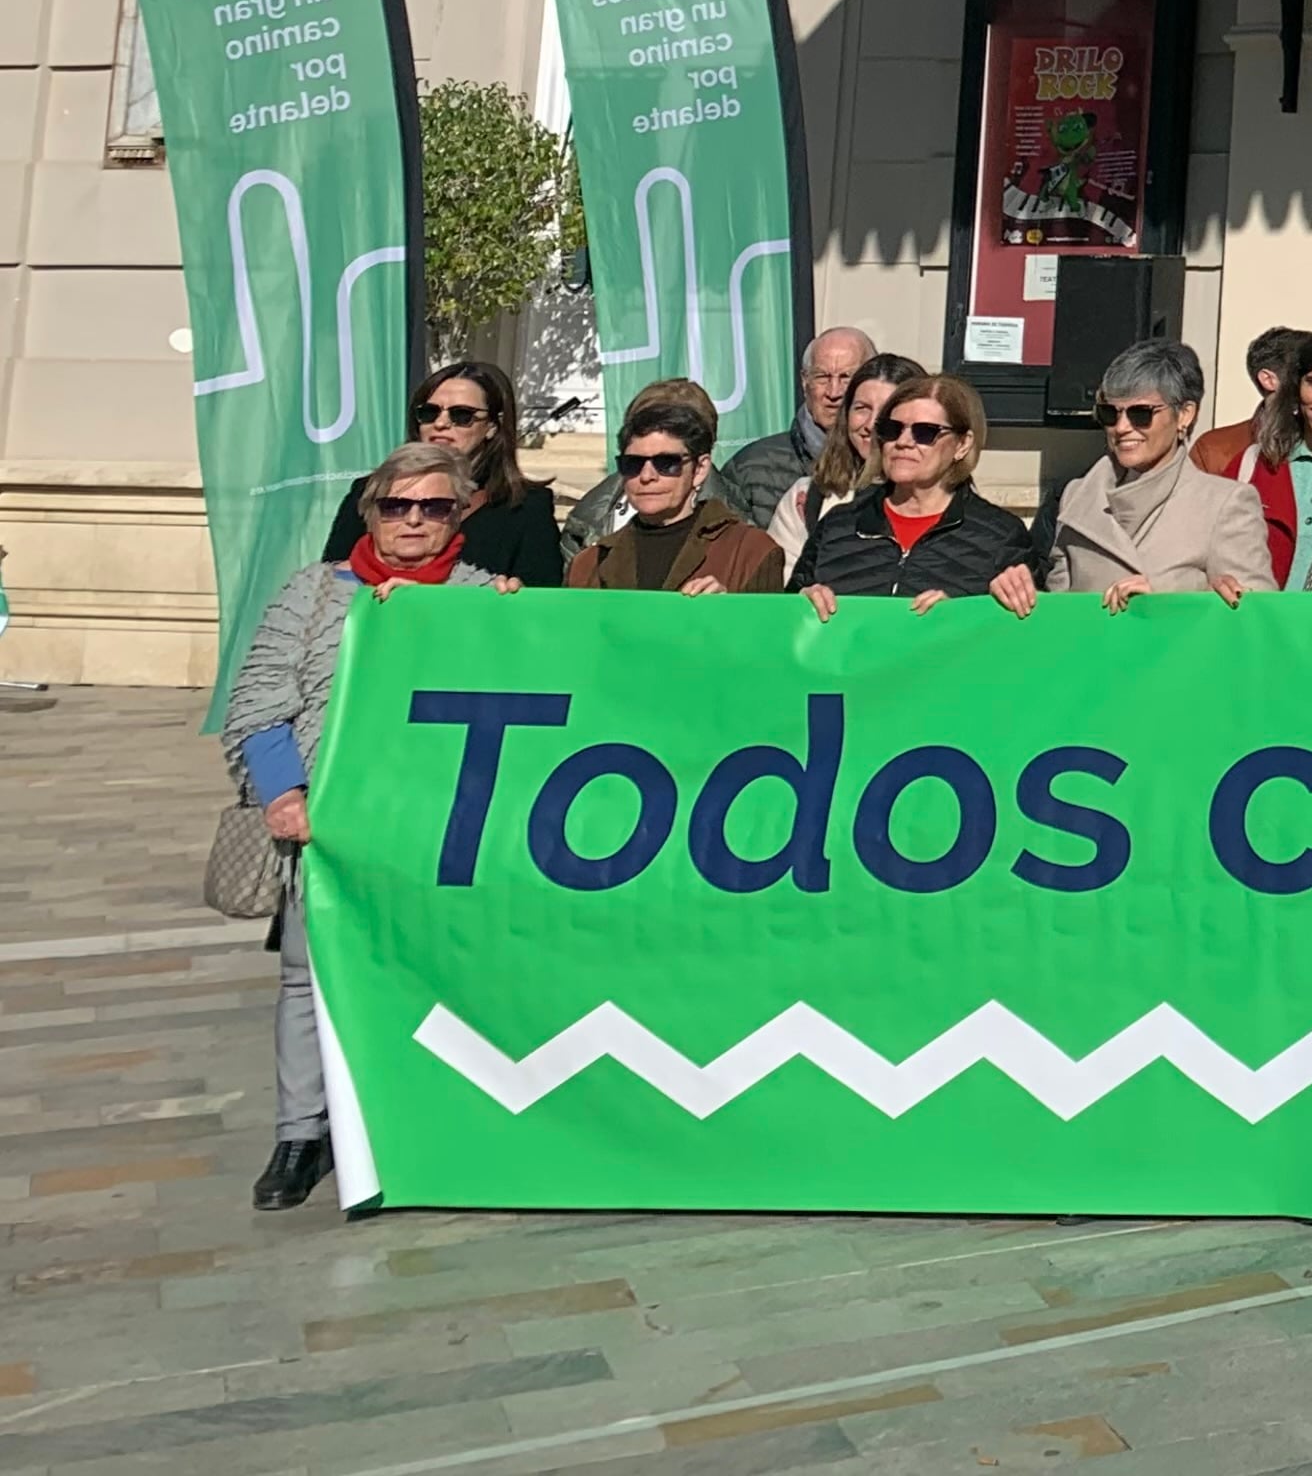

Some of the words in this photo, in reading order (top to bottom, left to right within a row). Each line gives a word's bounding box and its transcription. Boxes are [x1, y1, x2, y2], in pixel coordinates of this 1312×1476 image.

[1034, 46, 1124, 74] DRILO
[1036, 73, 1118, 101] ROCK
[407, 690, 1131, 894] Todos
